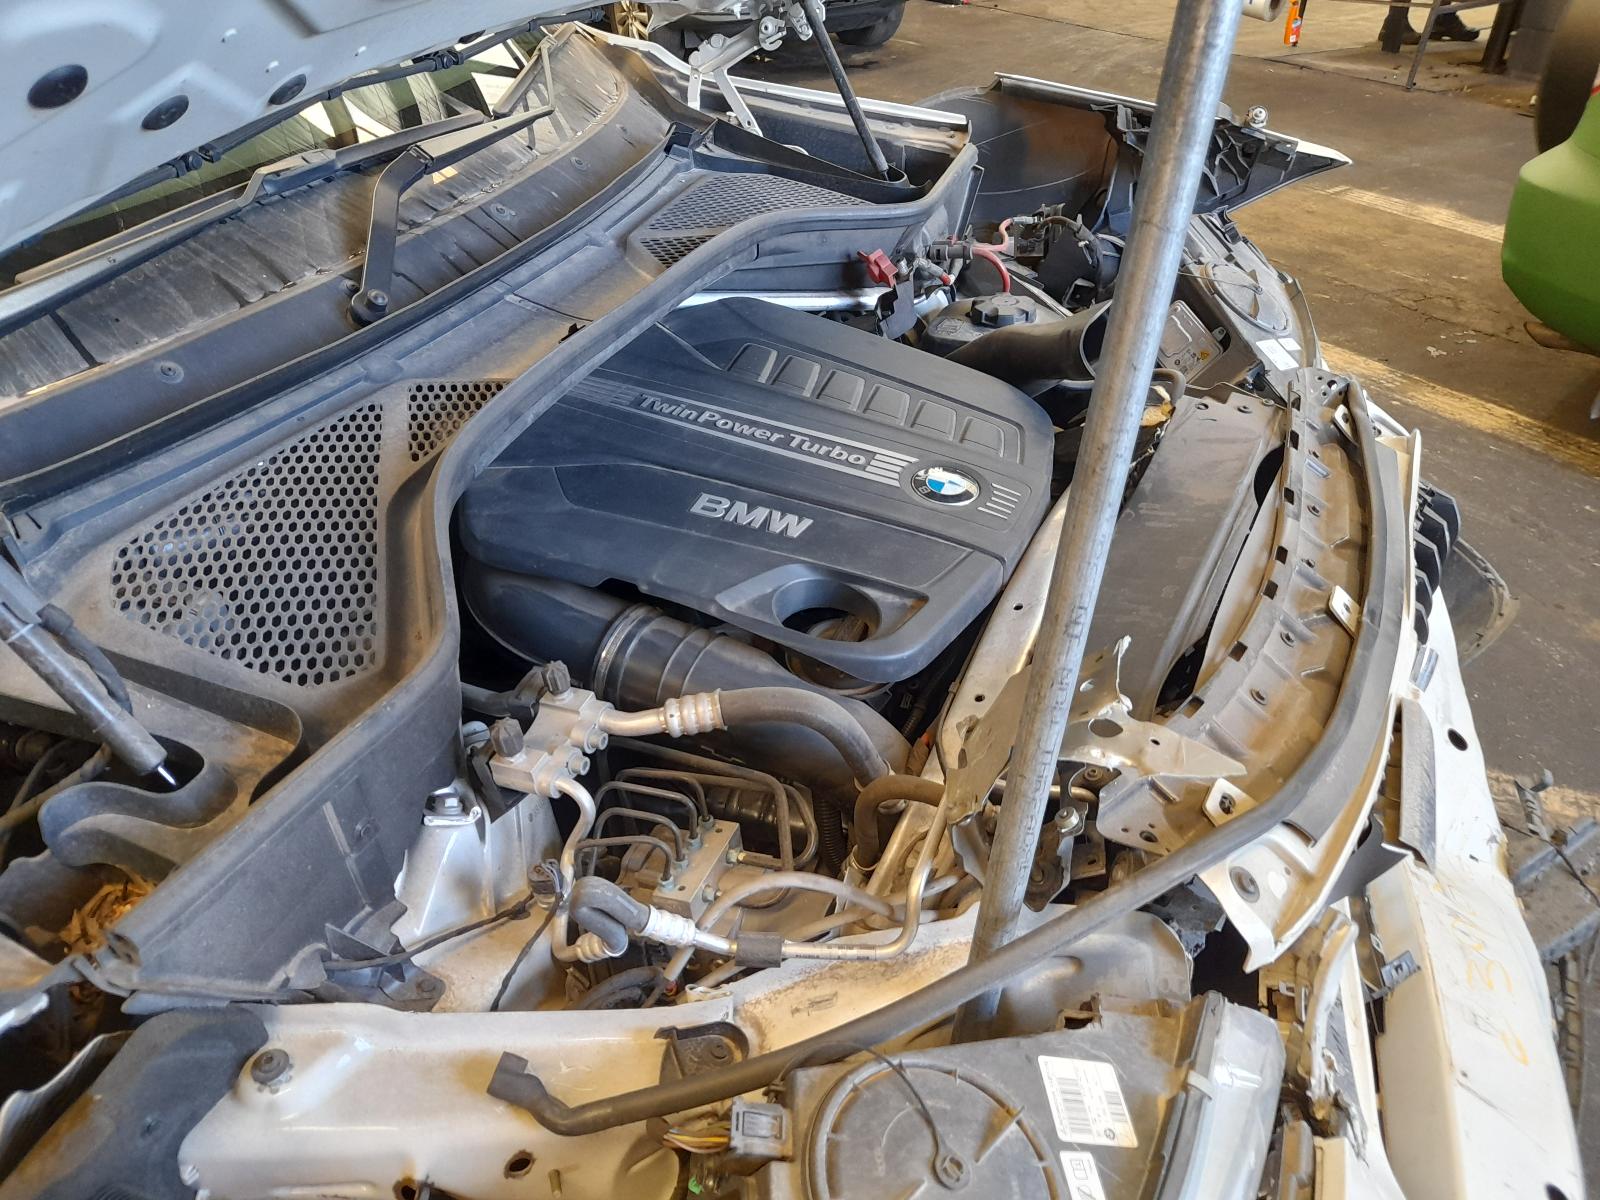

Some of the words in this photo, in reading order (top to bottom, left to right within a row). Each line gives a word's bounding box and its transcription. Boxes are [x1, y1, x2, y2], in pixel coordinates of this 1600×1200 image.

[639, 393, 784, 442] TwinPower
[789, 433, 866, 466] Turbo
[689, 492, 814, 539] BMW
